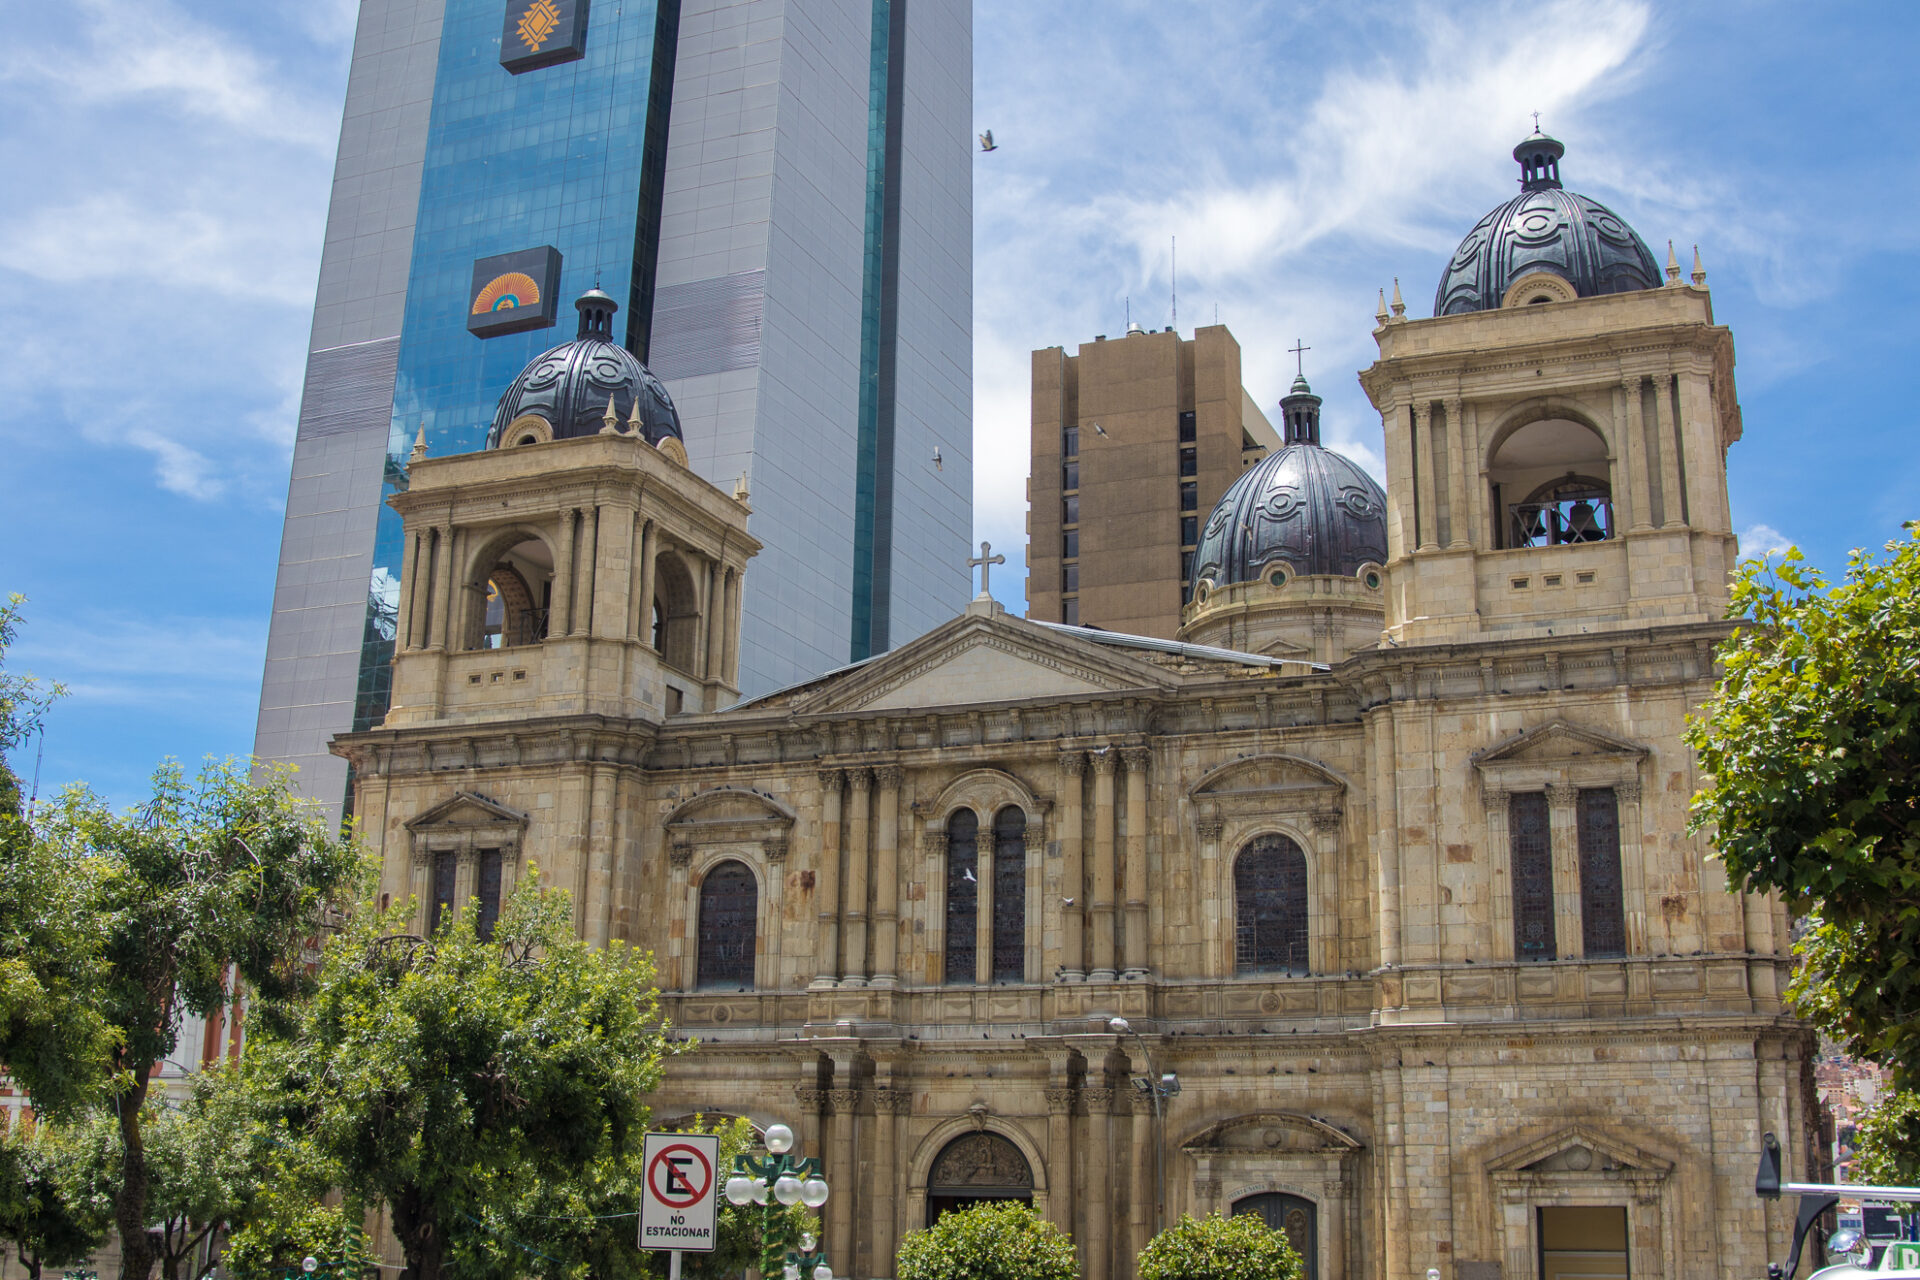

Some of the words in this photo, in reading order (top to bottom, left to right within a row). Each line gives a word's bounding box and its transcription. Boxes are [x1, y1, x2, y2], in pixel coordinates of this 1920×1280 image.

[666, 1158, 693, 1194] E
[670, 1215, 685, 1225] NO
[646, 1227, 710, 1238] ESTACIONAR
